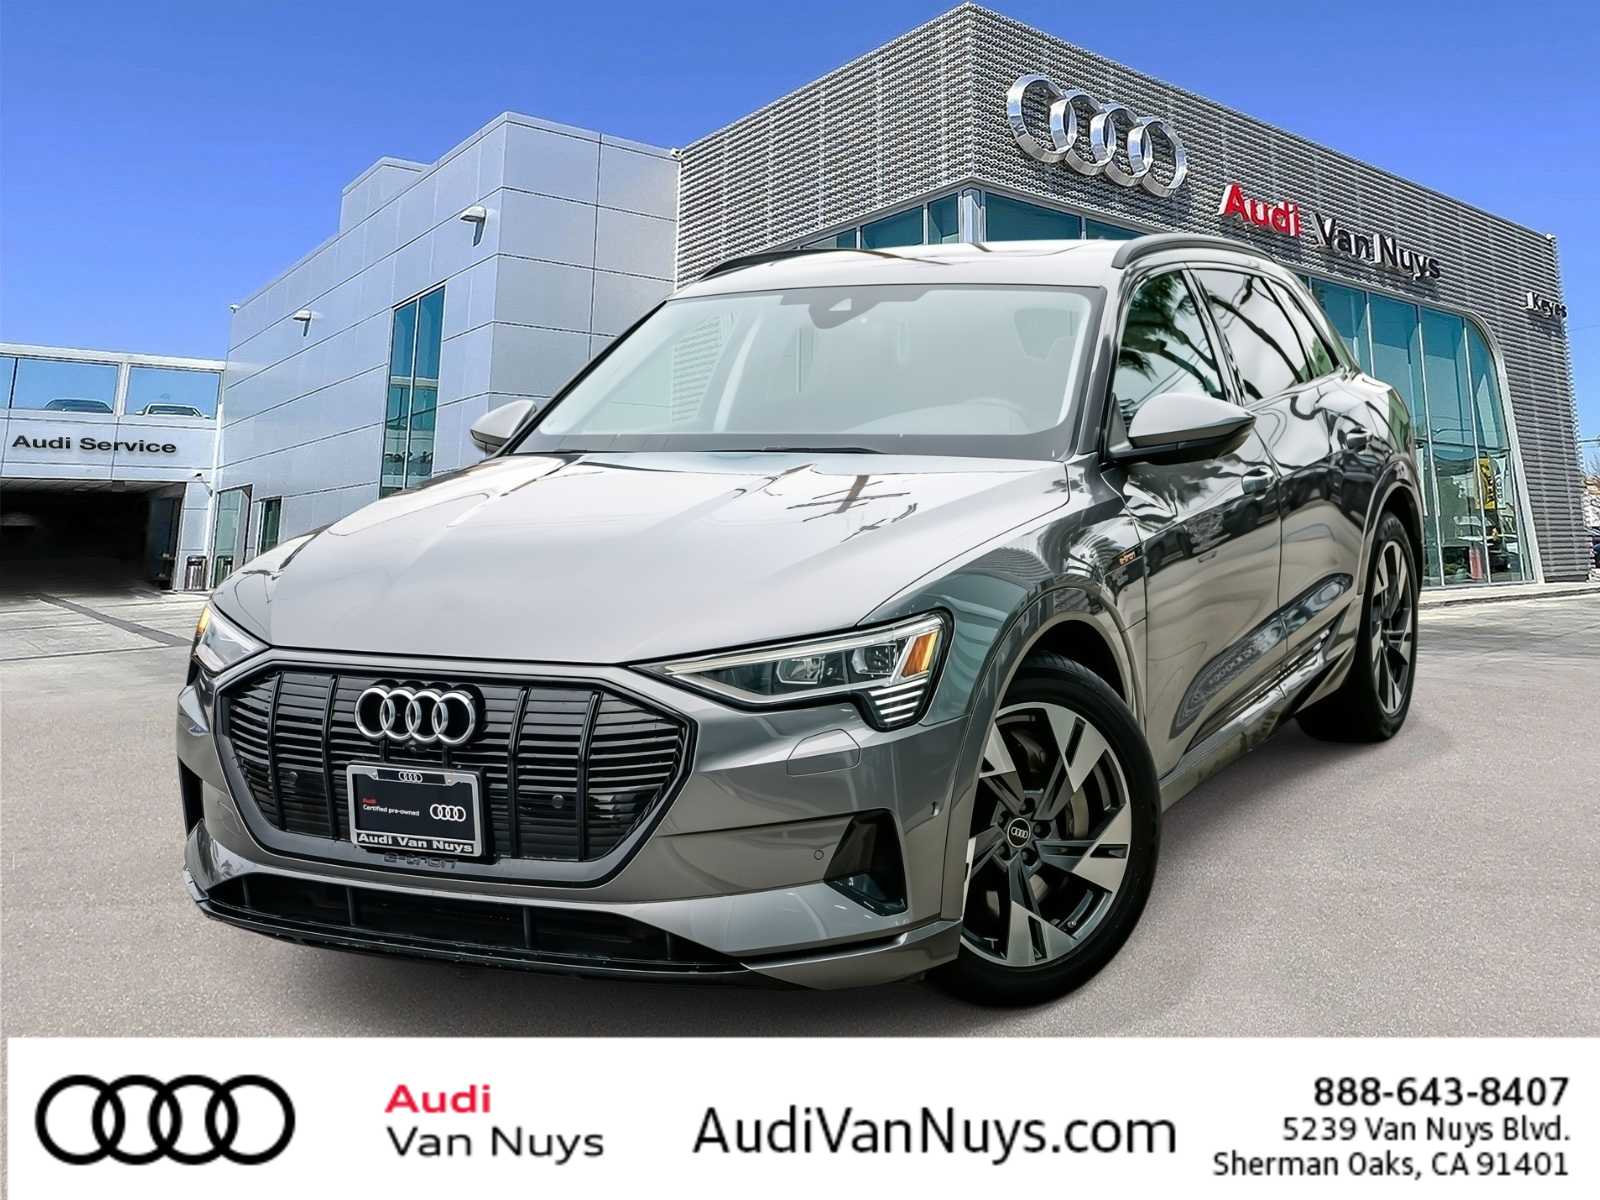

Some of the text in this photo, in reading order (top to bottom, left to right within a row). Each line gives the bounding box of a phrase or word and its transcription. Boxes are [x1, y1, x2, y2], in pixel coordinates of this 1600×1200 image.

[1217, 182, 1441, 281] Audi Van Nuys
[12, 434, 178, 454] Audi Service
[358, 833, 473, 853] Audi Van Nuys
